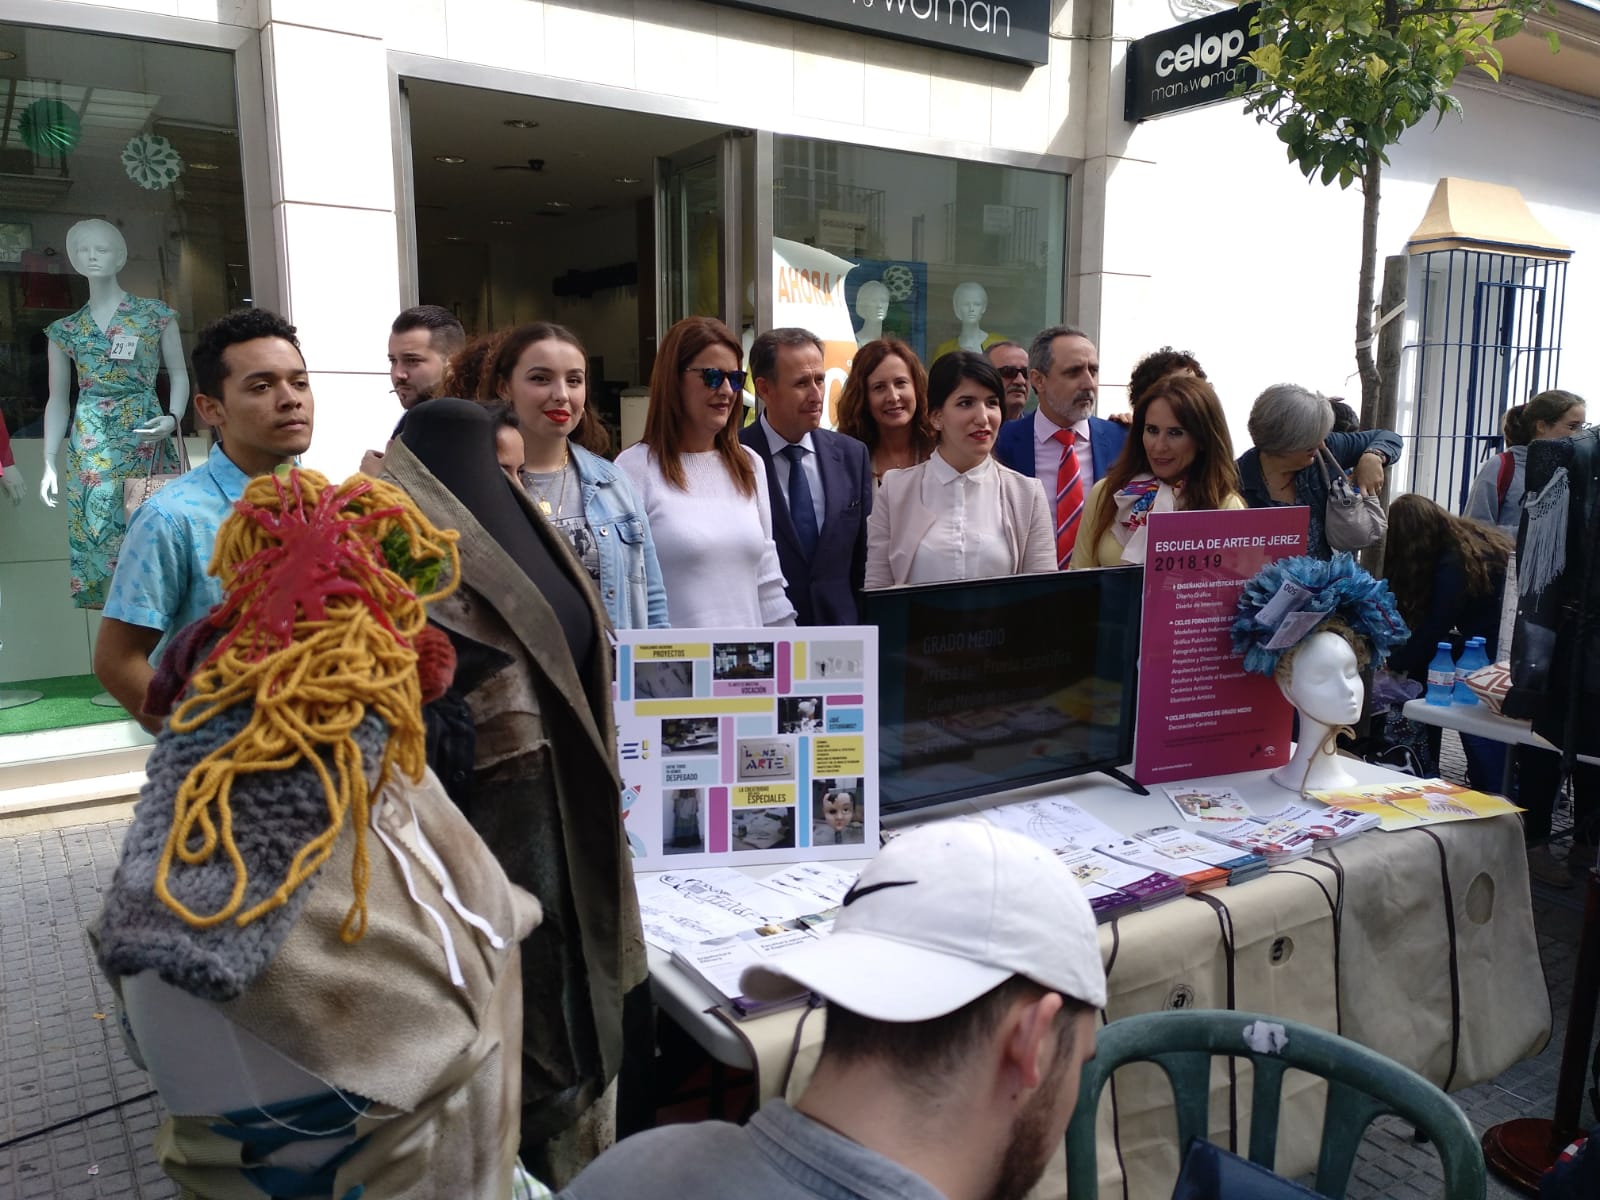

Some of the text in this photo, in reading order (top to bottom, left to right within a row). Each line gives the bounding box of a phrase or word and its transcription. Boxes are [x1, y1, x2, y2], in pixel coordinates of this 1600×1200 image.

[1155, 29, 1244, 77] celop
[778, 266, 834, 306] AHORA
[1155, 534, 1301, 553] ESCUELA DE ARTE DE JEREZ
[747, 793, 786, 804] ESPECIALES
